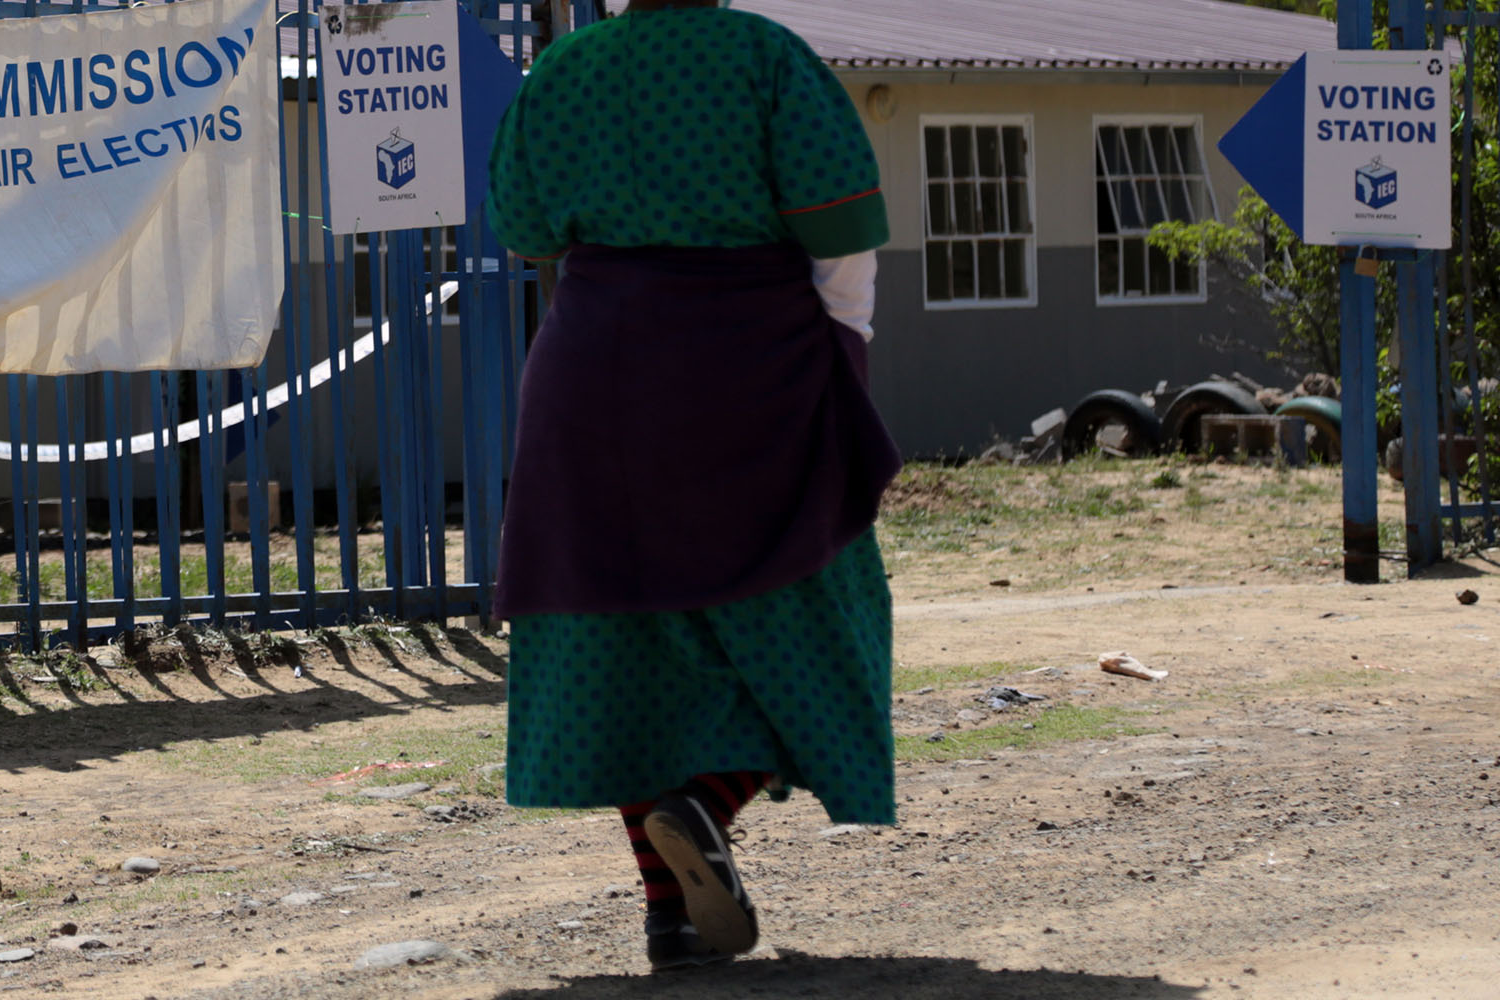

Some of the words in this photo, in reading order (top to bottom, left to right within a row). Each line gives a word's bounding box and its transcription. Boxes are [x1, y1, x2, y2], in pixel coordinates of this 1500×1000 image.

[336, 44, 446, 76] VOTING
[338, 84, 448, 115] STATION
[1318, 85, 1436, 110] VOTING
[1317, 120, 1436, 143] STATION
[398, 153, 413, 176] IEC
[1377, 179, 1396, 199] IEC
